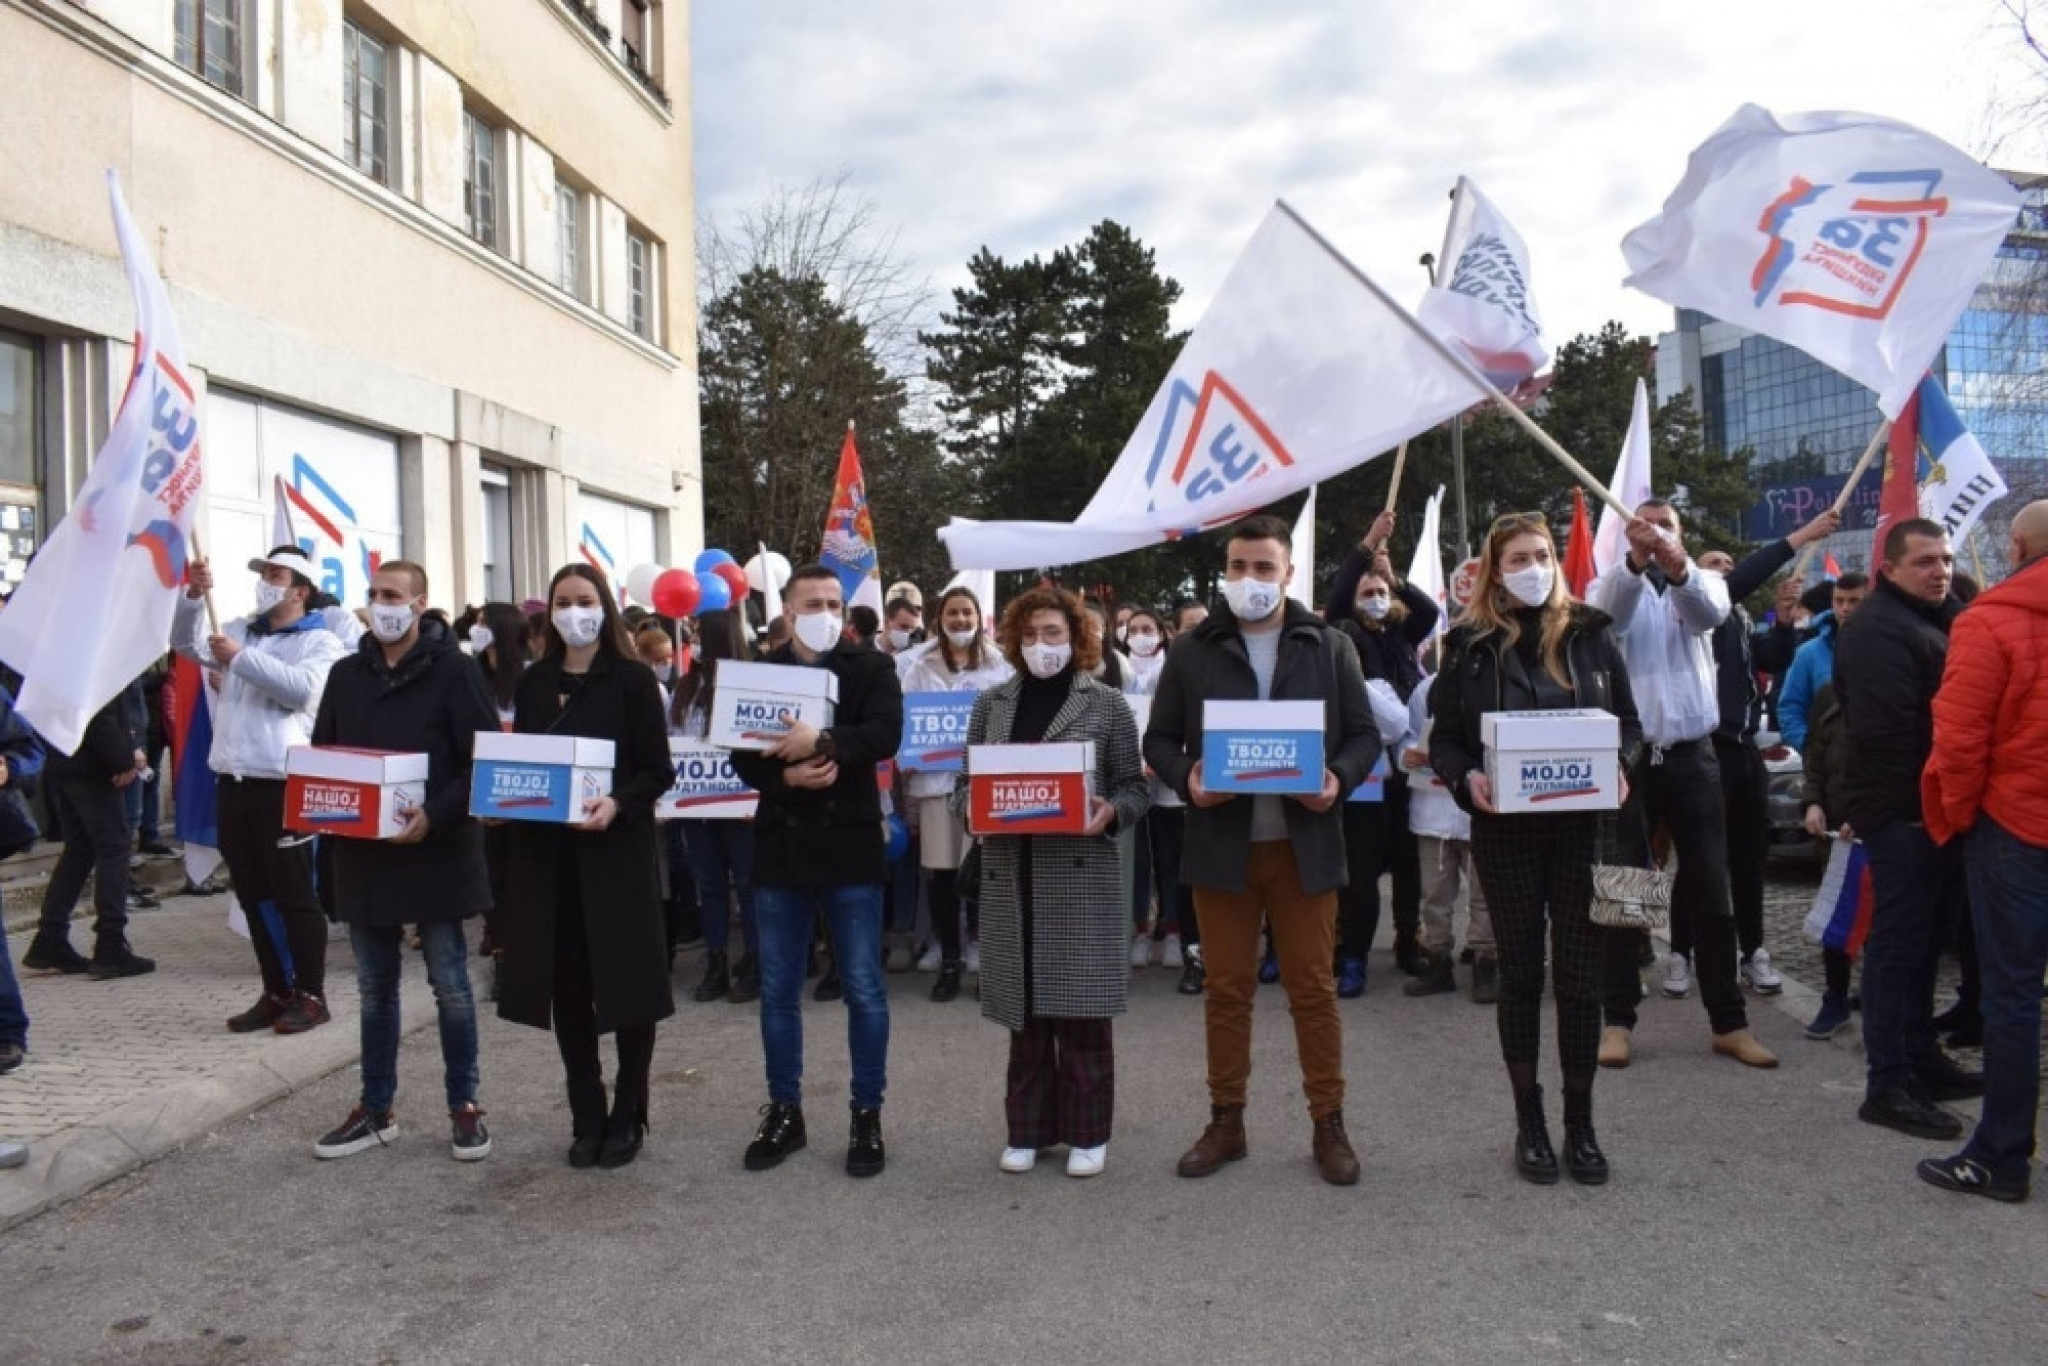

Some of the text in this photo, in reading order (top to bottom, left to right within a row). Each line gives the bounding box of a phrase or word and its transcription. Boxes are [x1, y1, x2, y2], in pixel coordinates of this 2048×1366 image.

[911, 714, 971, 732] ТВОЈ
[1228, 744, 1297, 759] ТВОЈОЈ
[1521, 764, 1592, 780] МОЈОЈ
[493, 773, 550, 789] ТВОЈОЈ
[304, 788, 360, 806] НАШОЈ
[992, 786, 1060, 801] НАШОЈ
